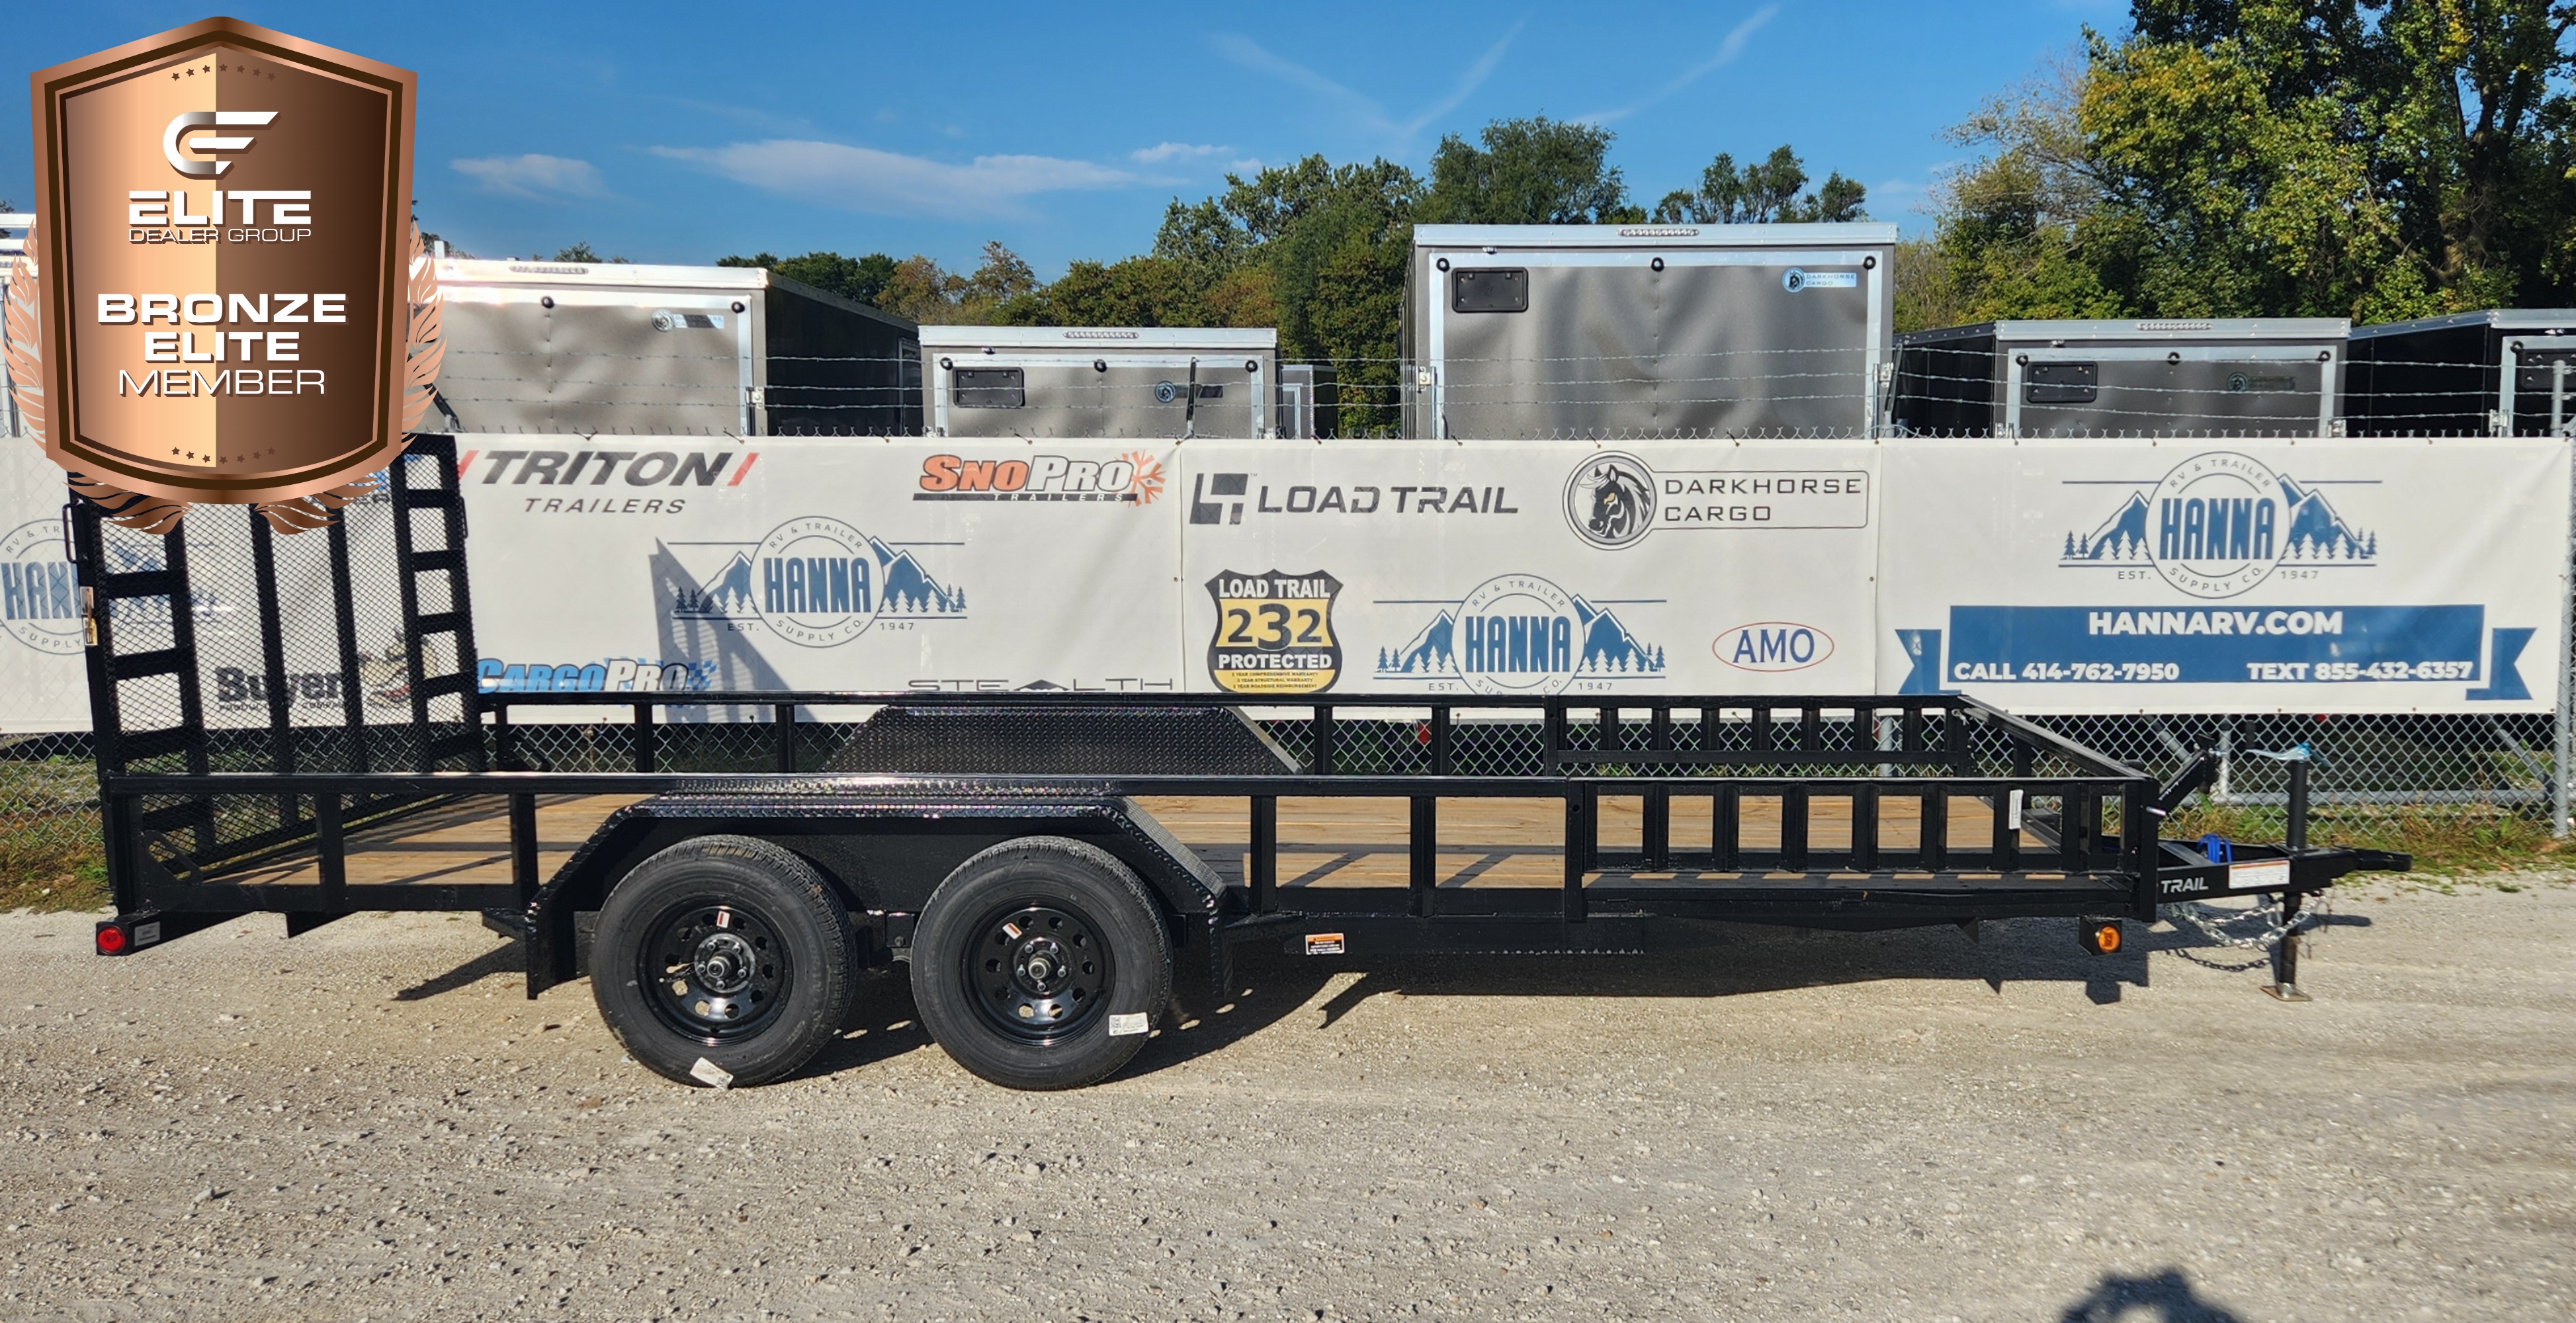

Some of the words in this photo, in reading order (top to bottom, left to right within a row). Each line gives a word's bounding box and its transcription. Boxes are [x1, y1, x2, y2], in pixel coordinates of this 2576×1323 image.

[482, 451, 734, 486] TRITON
[2170, 472, 2186, 488] RV
[2210, 458, 2271, 488] TRAILER
[994, 493, 1123, 501] TRAILERS
[1665, 479, 1862, 494] DARKHORSE
[525, 498, 685, 514] TRAILERS
[1258, 486, 1381, 513] LOAD
[1391, 486, 1518, 514] TRAIL
[1665, 506, 1771, 521] CARGO
[769, 534, 783, 548] RV
[805, 523, 863, 549] TRAILER
[2159, 497, 2275, 560] HANNA
[6, 538, 20, 553] RV
[763, 557, 871, 613] HANNA
[2118, 570, 2151, 579] EST.
[2281, 570, 2319, 579] 1947
[2168, 568, 2231, 591] SUPPLY
[2, 562, 81, 620] HAN
[1219, 579, 1269, 598] LOAD
[1274, 579, 1330, 598] TRAIL
[1472, 591, 1486, 607] RV
[1509, 581, 1565, 607] TRAILER
[776, 620, 835, 641] SUPPLY
[1228, 603, 1322, 650] 232
[2089, 611, 2342, 635] HANNARV.COM
[19, 626, 82, 648] SUPPLY
[1465, 616, 1570, 672] HANNA
[1733, 628, 1815, 663] AMO
[1219, 654, 1332, 669] PROTECTED
[1954, 662, 2016, 680] CALL
[2022, 662, 2180, 680] 414-762-7950
[2247, 662, 2310, 680] TEXT
[2315, 662, 2473, 680] 855-432-6357
[1429, 683, 1459, 691] EST.
[2161, 876, 2209, 894] TRAIL
